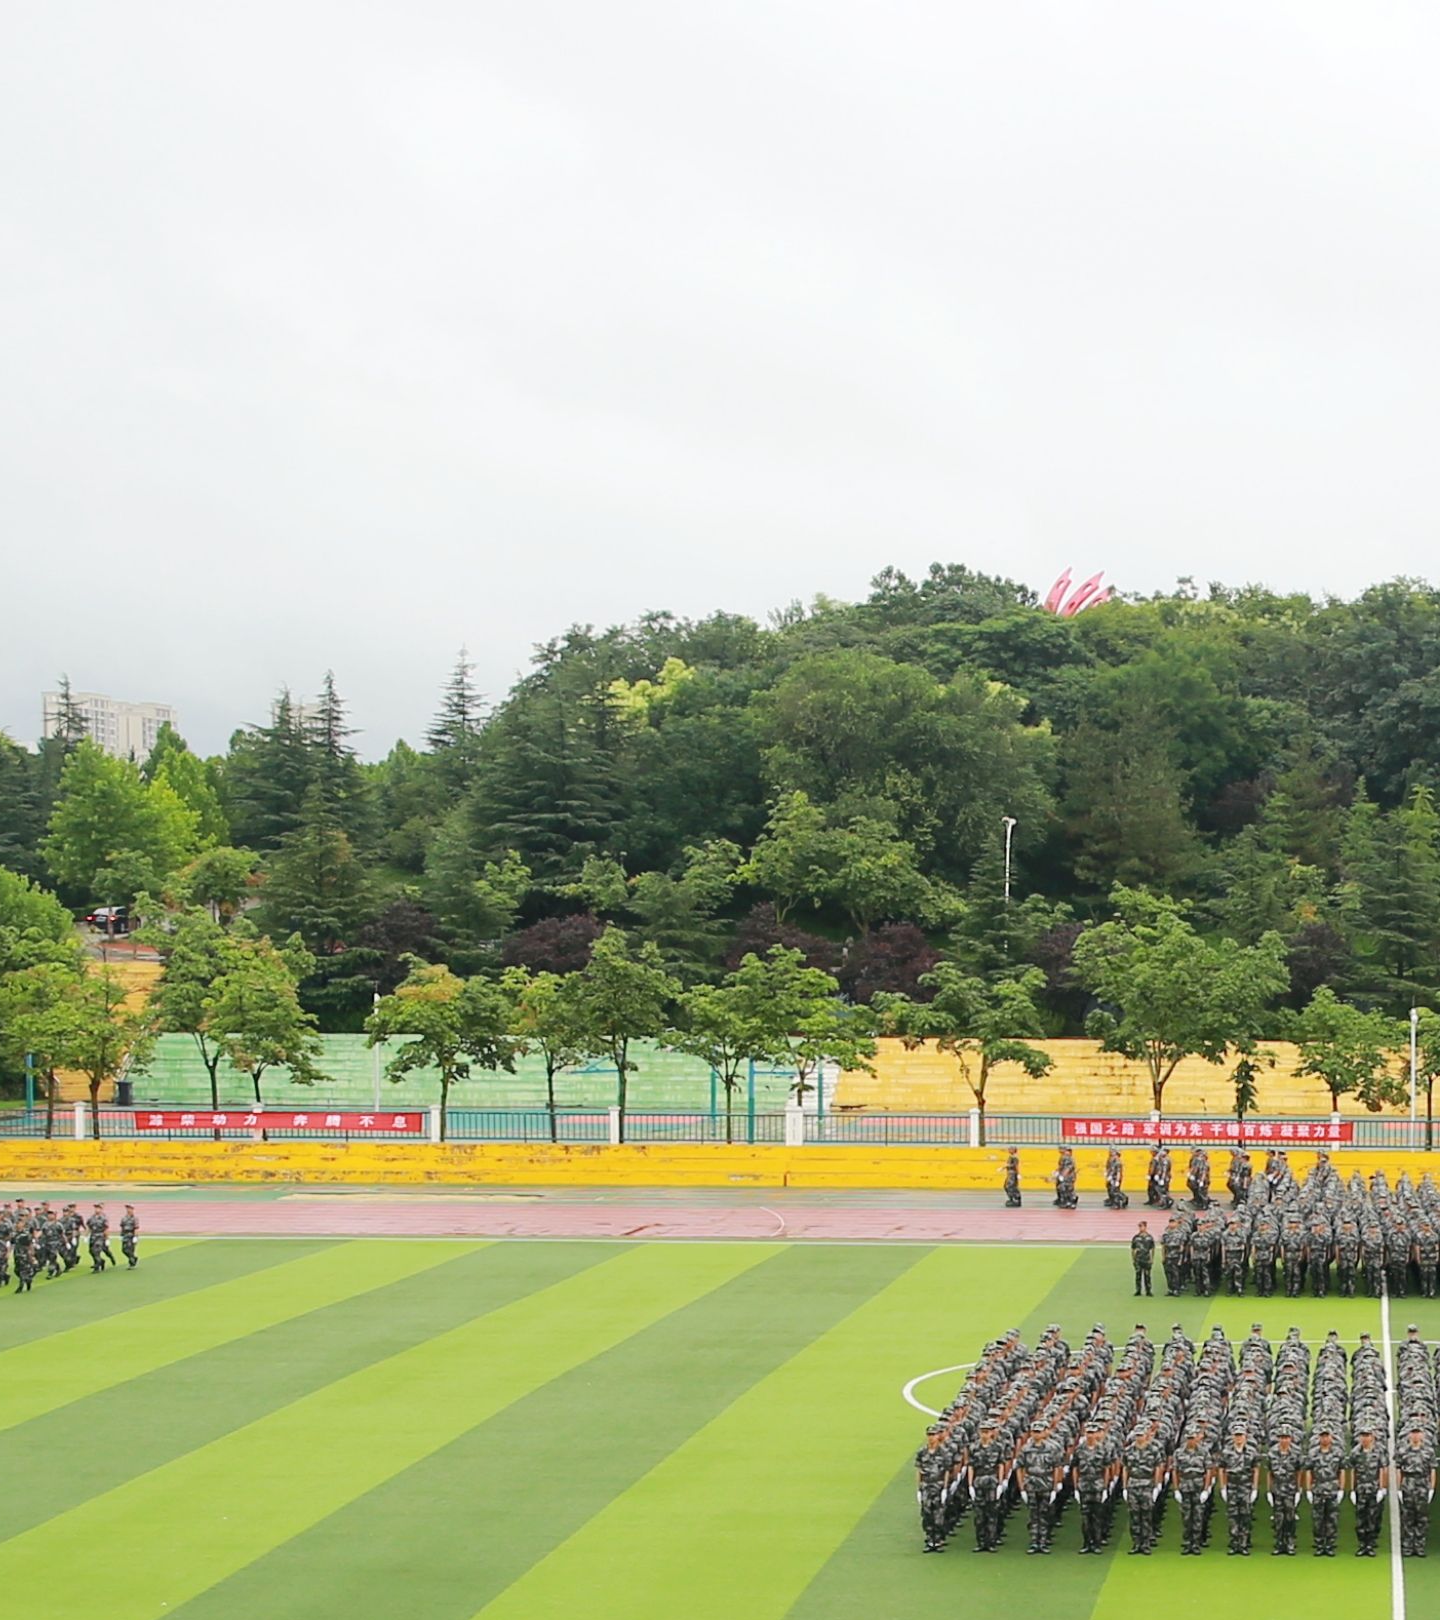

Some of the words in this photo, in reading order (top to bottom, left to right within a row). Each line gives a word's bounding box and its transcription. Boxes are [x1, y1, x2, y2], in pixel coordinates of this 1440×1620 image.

[148, 1113, 258, 1127] 潍柴动力
[292, 1114, 408, 1129] 奔腾不息
[1074, 1122, 1135, 1136] 强国之路
[1142, 1122, 1203, 1137] 军训为先
[1209, 1123, 1272, 1138] 千锤百炼
[1279, 1124, 1342, 1139] 凝聚力量
